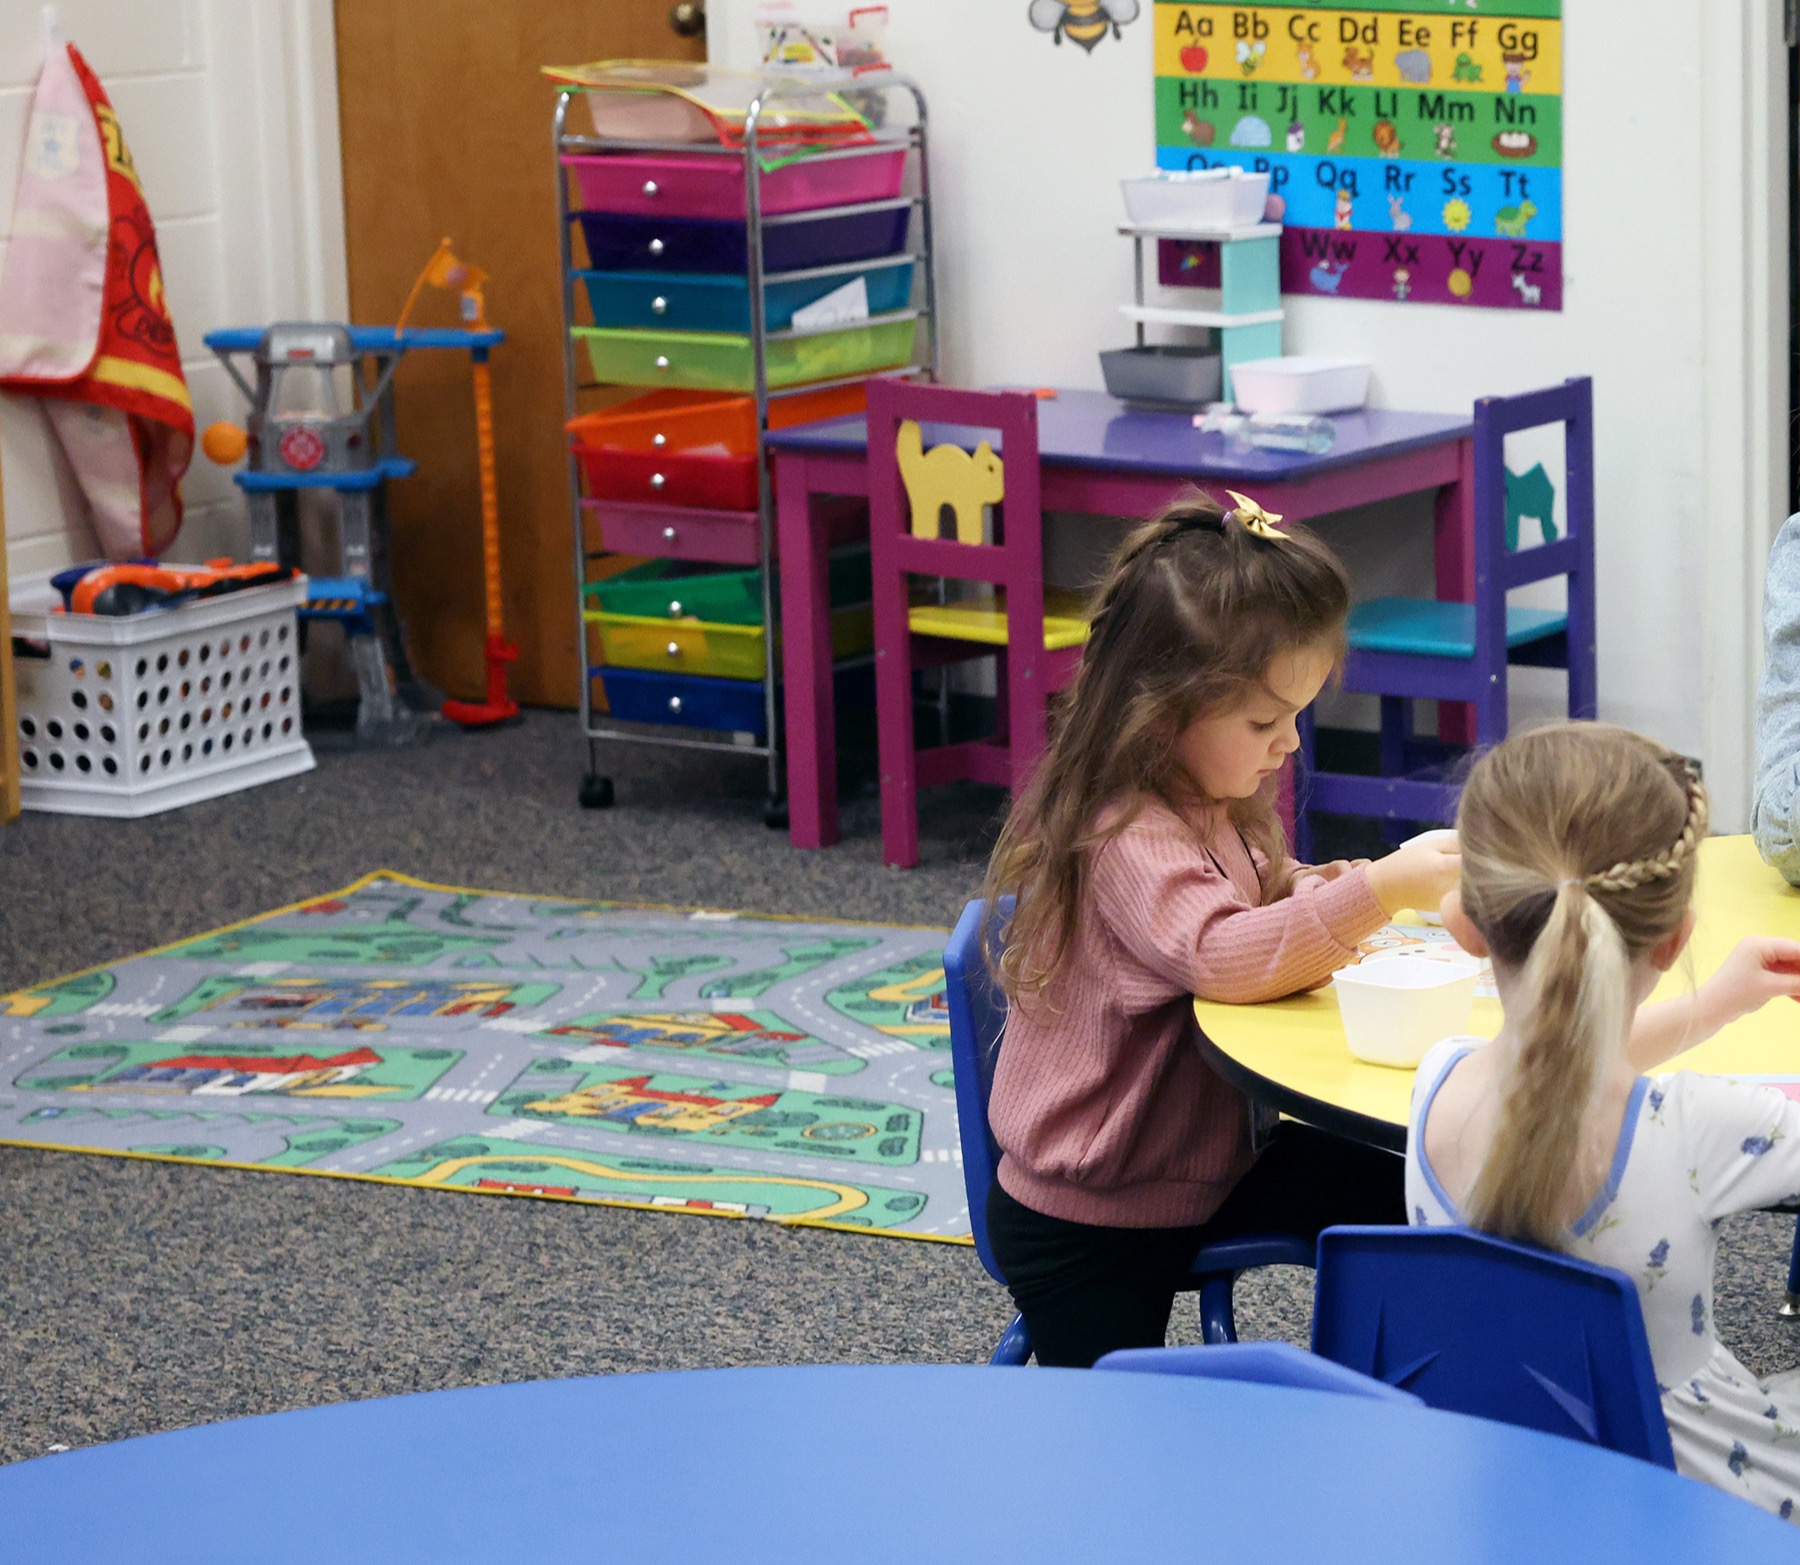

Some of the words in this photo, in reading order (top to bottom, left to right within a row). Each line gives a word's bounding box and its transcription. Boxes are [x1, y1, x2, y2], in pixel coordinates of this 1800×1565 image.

[1175, 10, 1214, 37] Aa
[1233, 12, 1269, 39] Bb
[1288, 14, 1320, 42] Cc
[1340, 17, 1378, 44] Dd
[1399, 20, 1431, 46] Ee
[1452, 21, 1478, 48] Ff
[1498, 24, 1539, 60] Gg
[1180, 82, 1219, 109] Hh
[1238, 83, 1258, 111] Ii
[1278, 86, 1298, 123] Jj
[1319, 88, 1356, 116] Kk
[1376, 92, 1398, 118] Ll
[1418, 94, 1475, 121] Mm
[1496, 97, 1537, 124] Nn
[1316, 161, 1359, 198] Qq
[1385, 165, 1417, 193] Rr
[1442, 167, 1472, 196] Ss
[1499, 171, 1529, 199] Tt
[1302, 232, 1357, 260] Ww
[1384, 237, 1420, 264] Xx
[1448, 242, 1484, 278] Yy
[1511, 245, 1544, 273] Zz
